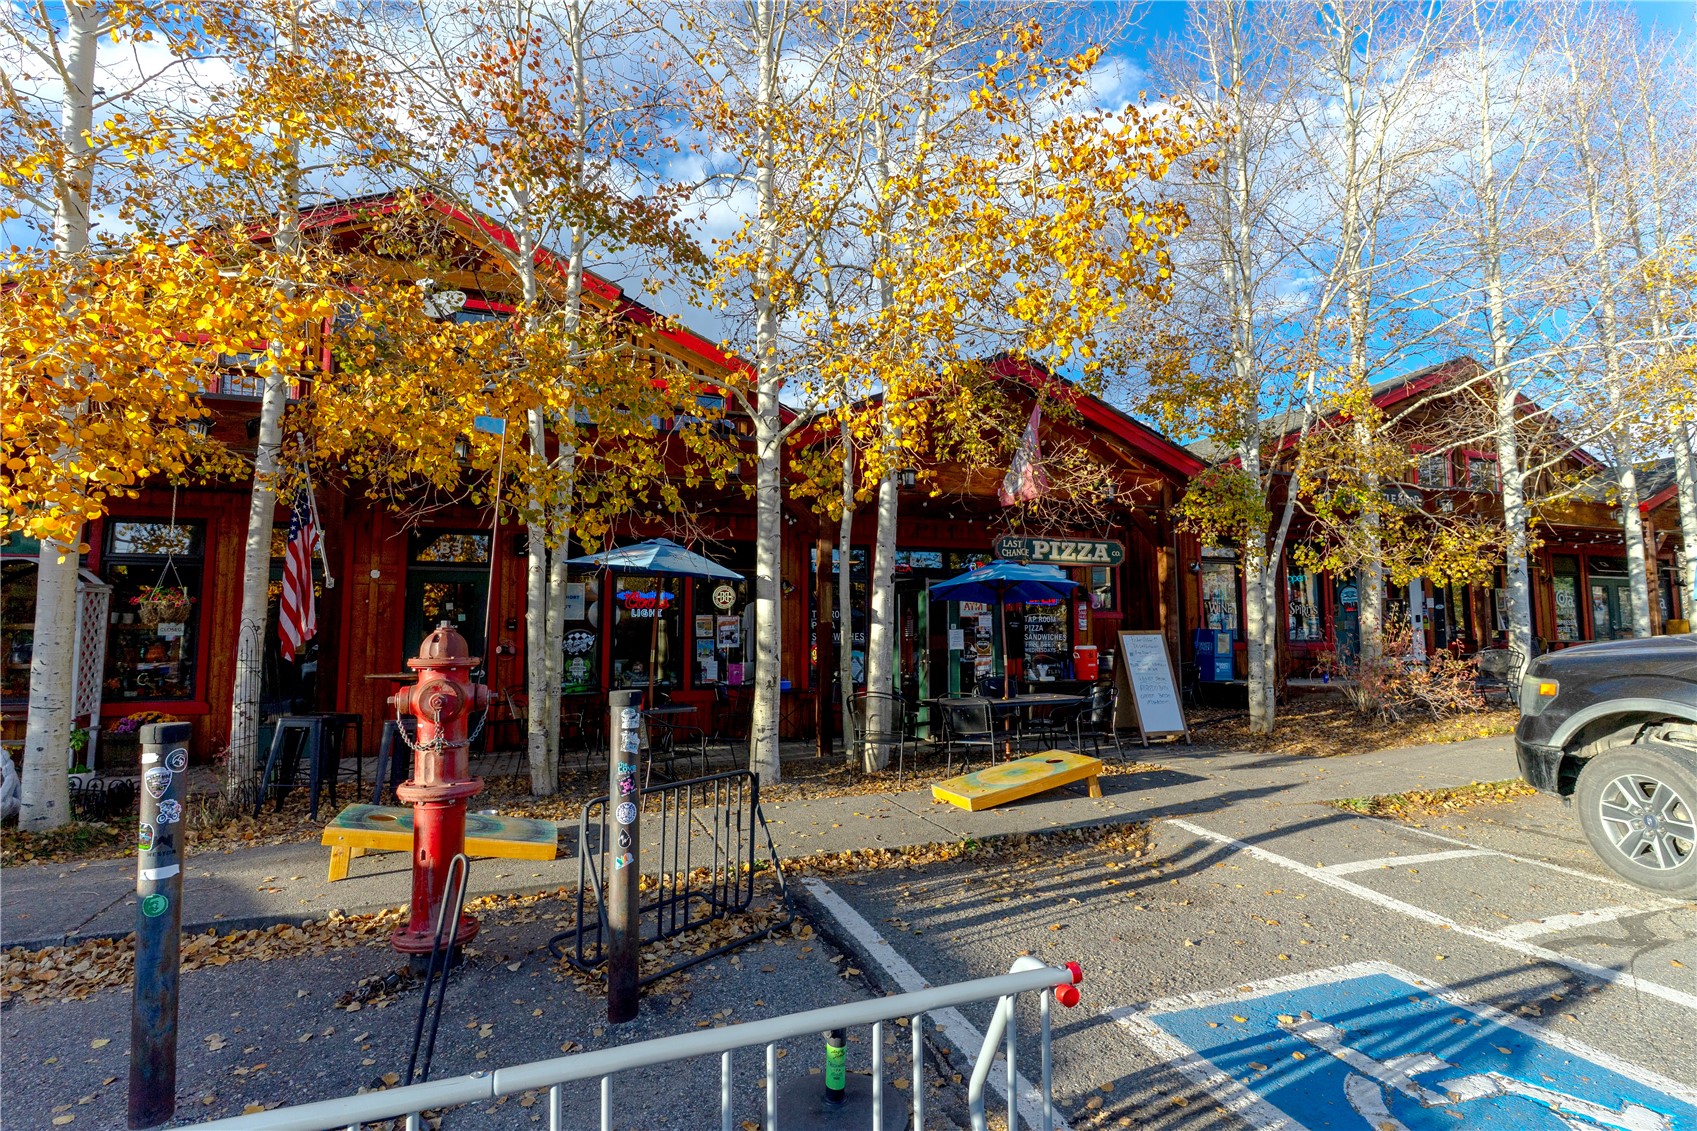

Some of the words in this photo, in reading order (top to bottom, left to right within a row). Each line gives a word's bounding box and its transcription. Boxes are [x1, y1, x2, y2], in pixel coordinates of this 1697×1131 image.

[1003, 540, 1022, 548] LAST
[1002, 548, 1029, 557] CHANCE
[1032, 540, 1111, 562] PIZZA
[624, 591, 670, 609] Coos
[964, 603, 983, 611] ATM
